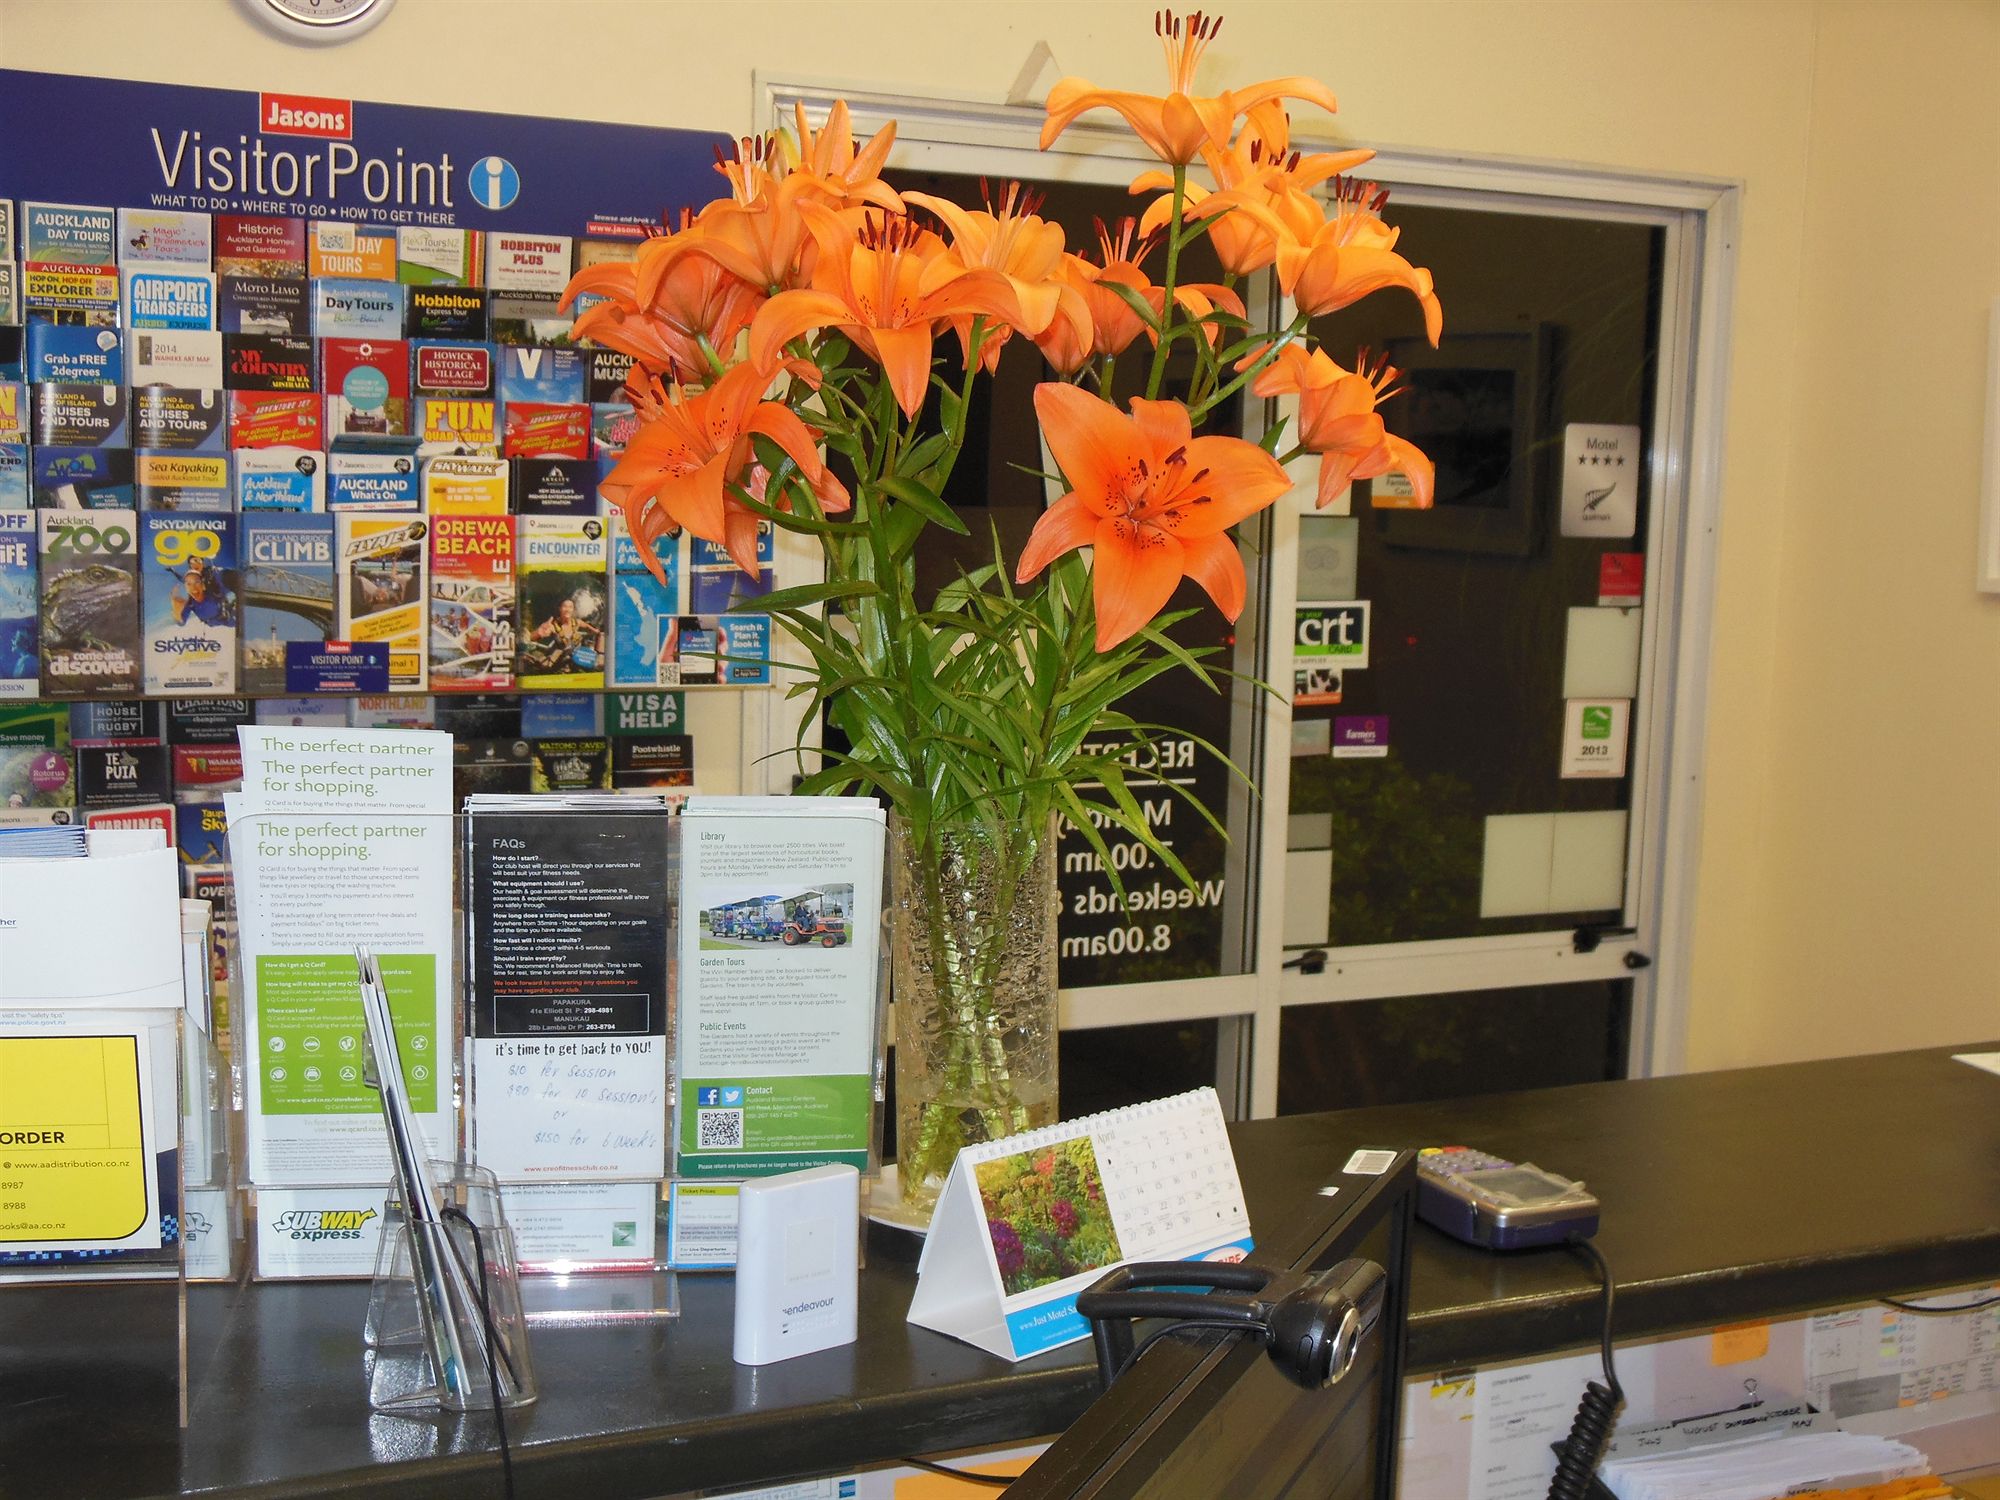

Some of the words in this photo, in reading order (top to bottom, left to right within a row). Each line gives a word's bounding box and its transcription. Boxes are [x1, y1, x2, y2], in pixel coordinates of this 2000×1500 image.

[268, 101, 345, 131] Jasons
[151, 193, 186, 207] WHAT
[190, 195, 207, 209] TO
[210, 197, 228, 210] DO
[242, 200, 287, 214] WHERE
[290, 202, 306, 216] TO
[309, 203, 327, 216] GO
[340, 206, 368, 220] HOW
[371, 207, 387, 221] TO
[390, 209, 414, 223] GET
[417, 210, 455, 225] THERE
[36, 213, 111, 229] AUCKLAND
[48, 229, 69, 239] DAY
[73, 231, 111, 242] TOURS
[238, 224, 283, 235] Historic
[227, 236, 263, 244] Auckland
[266, 237, 295, 246] Homes
[358, 237, 383, 254] DAY
[500, 240, 562, 253] HOBBITON
[321, 255, 362, 272] TOURS
[513, 254, 544, 265] PLUS
[42, 265, 102, 274] AUCKLAND
[30, 284, 93, 296] EXPLORER
[135, 279, 208, 301] AIRPORT
[499, 291, 533, 300] Auckland
[326, 297, 351, 312] Day
[356, 298, 394, 310] Tours
[415, 294, 481, 309] Hobbiton
[135, 301, 208, 317] TRANSFERS
[426, 309, 451, 317] Express
[155, 344, 177, 353] 2014
[44, 353, 70, 364] Grab
[80, 355, 108, 365] FREE
[434, 352, 474, 360] HOWICK
[231, 362, 308, 376] COUNTRY
[425, 361, 482, 370] HISTORICAL
[52, 366, 101, 378] 2degrees
[433, 370, 474, 379] VILLAGE
[40, 407, 91, 417] CRUISES
[140, 409, 190, 419] CRUISES
[425, 400, 496, 431] FUN
[70, 418, 110, 428] TOURS
[139, 420, 165, 430] AND
[168, 420, 208, 431] TOURS
[424, 431, 454, 443] QUAD
[1586, 438, 1619, 449] Motel
[149, 462, 168, 471] Sea
[170, 463, 219, 474] Kayaking
[433, 461, 496, 474] SKYWALK
[244, 477, 291, 490] Auckland
[339, 480, 408, 491] AUCKLAND
[350, 491, 381, 499] What's
[383, 491, 397, 499] On
[47, 516, 94, 525] Auckland
[149, 519, 226, 531] SKYDIVING!
[436, 520, 510, 536] OREWA
[256, 534, 298, 542] AUCKLAND
[154, 529, 221, 567] go
[254, 543, 330, 561] CLIMB
[436, 538, 511, 555] BEACH
[529, 541, 601, 555] ENCOUNTER
[730, 623, 755, 631] Search
[756, 623, 765, 631] it.
[1299, 610, 1355, 646] crt
[735, 631, 751, 640] Plan
[753, 631, 761, 640] it.
[154, 639, 222, 655] Skydive
[733, 640, 750, 648] Book
[752, 640, 761, 648] it.
[73, 652, 103, 661] come
[104, 650, 125, 661] and
[311, 655, 340, 664] VISITOR
[342, 655, 364, 664] POINT
[50, 658, 133, 676] discover
[358, 697, 428, 711] NORTHLAND
[619, 695, 677, 711] VISA
[97, 706, 137, 716] HOUSE
[97, 721, 137, 731] RUGBY
[620, 712, 677, 728] HELP
[0, 734, 19, 742] Save
[20, 735, 46, 743] money
[261, 737, 294, 751] The
[300, 738, 364, 753] perfect
[370, 742, 434, 755] partner
[1582, 745, 1609, 756] 2013
[105, 752, 120, 765] TE
[105, 765, 138, 780] PUIA
[262, 760, 295, 774] The
[301, 761, 364, 777] perfect
[370, 765, 434, 779] partner
[264, 778, 289, 792] for
[295, 779, 378, 797] shopping.
[257, 823, 289, 837] The
[295, 822, 358, 841] perfect
[364, 824, 427, 841] partner
[700, 832, 726, 842] Library
[493, 839, 526, 849] FAQs
[258, 842, 284, 857] for
[289, 842, 372, 860] shopping.
[545, 912, 568, 920] training
[700, 958, 725, 967] Garden
[727, 958, 745, 966] Tours
[700, 1022, 723, 1032] Public
[723, 1021, 747, 1031] Events
[496, 1043, 514, 1056] it's
[517, 1044, 541, 1056] time
[544, 1044, 555, 1055] to
[558, 1044, 577, 1057] get
[581, 1043, 607, 1055] back
[610, 1042, 622, 1054] to
[626, 1041, 651, 1054] YOU!
[567, 1064, 616, 1079] Session
[746, 1086, 773, 1095] Contact
[553, 1109, 568, 1120] or
[0, 1131, 65, 1145] ORDER
[1097, 1130, 1116, 1146] April
[14, 1160, 130, 1170] www.aadistribution.co.nz
[1, 1182, 24, 1190] 8987
[3, 1202, 26, 1210] 8988
[272, 1207, 378, 1232] SUBWAY
[0, 1222, 66, 1231] ooks@aa.co.nz
[291, 1229, 360, 1242] express
[787, 1297, 834, 1315] endeavour
